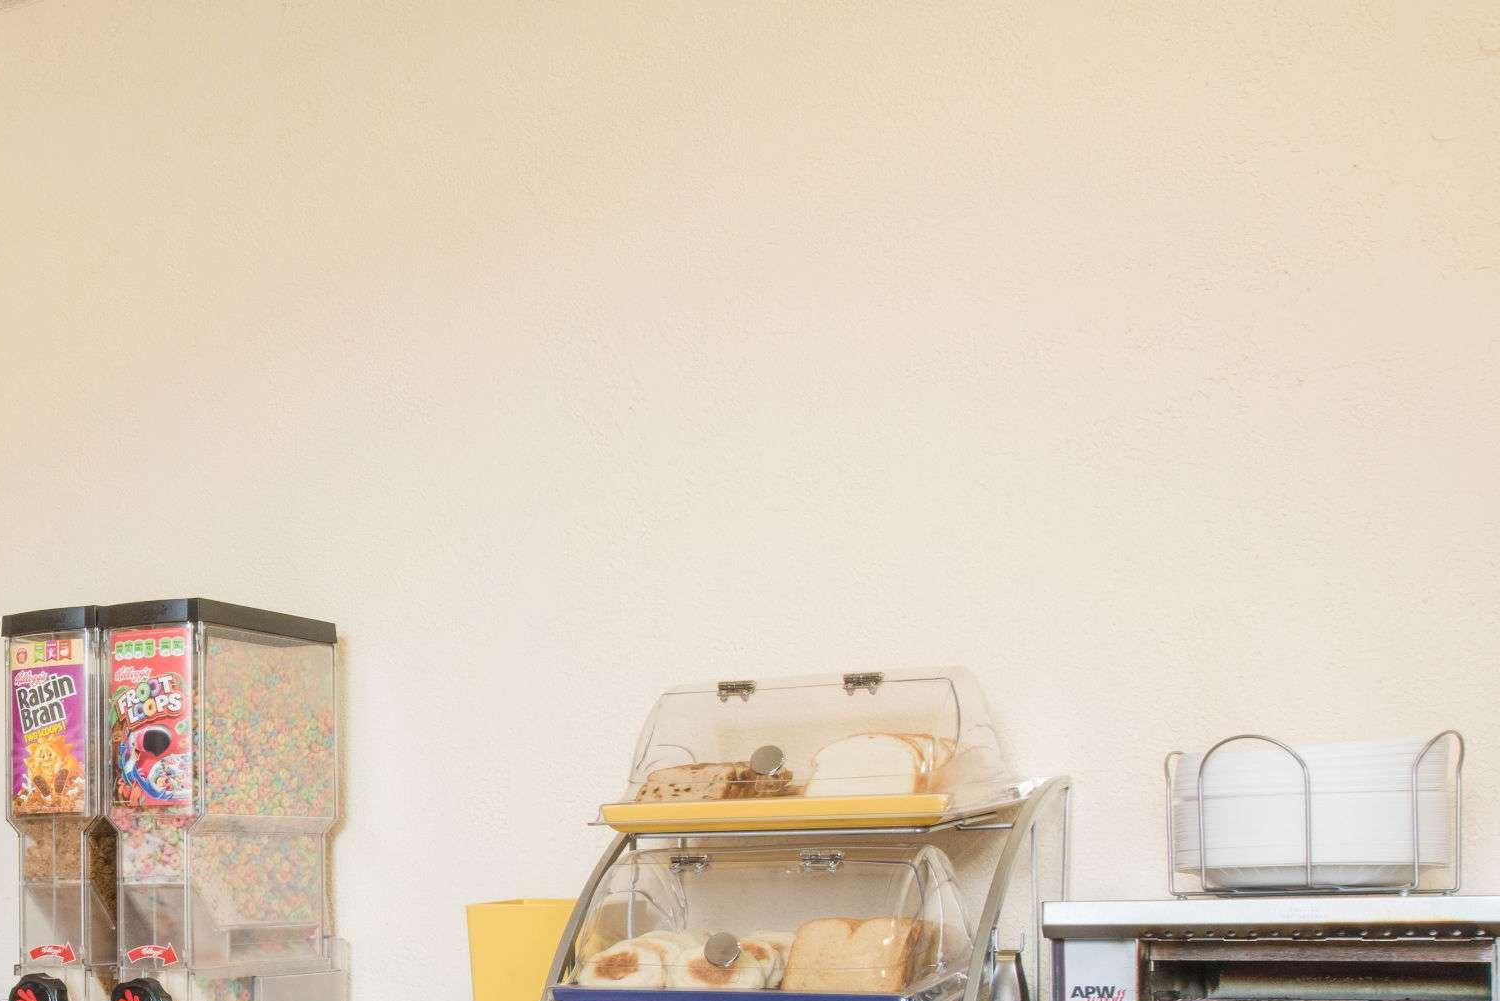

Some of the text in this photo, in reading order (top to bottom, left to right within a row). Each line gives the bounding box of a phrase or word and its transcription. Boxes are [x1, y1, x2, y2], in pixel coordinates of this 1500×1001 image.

[16, 674, 77, 709] Raisin
[118, 675, 173, 714] FROOT
[20, 701, 66, 732] Bran
[127, 692, 182, 723] LOOPS
[1071, 985, 1115, 998] APW
